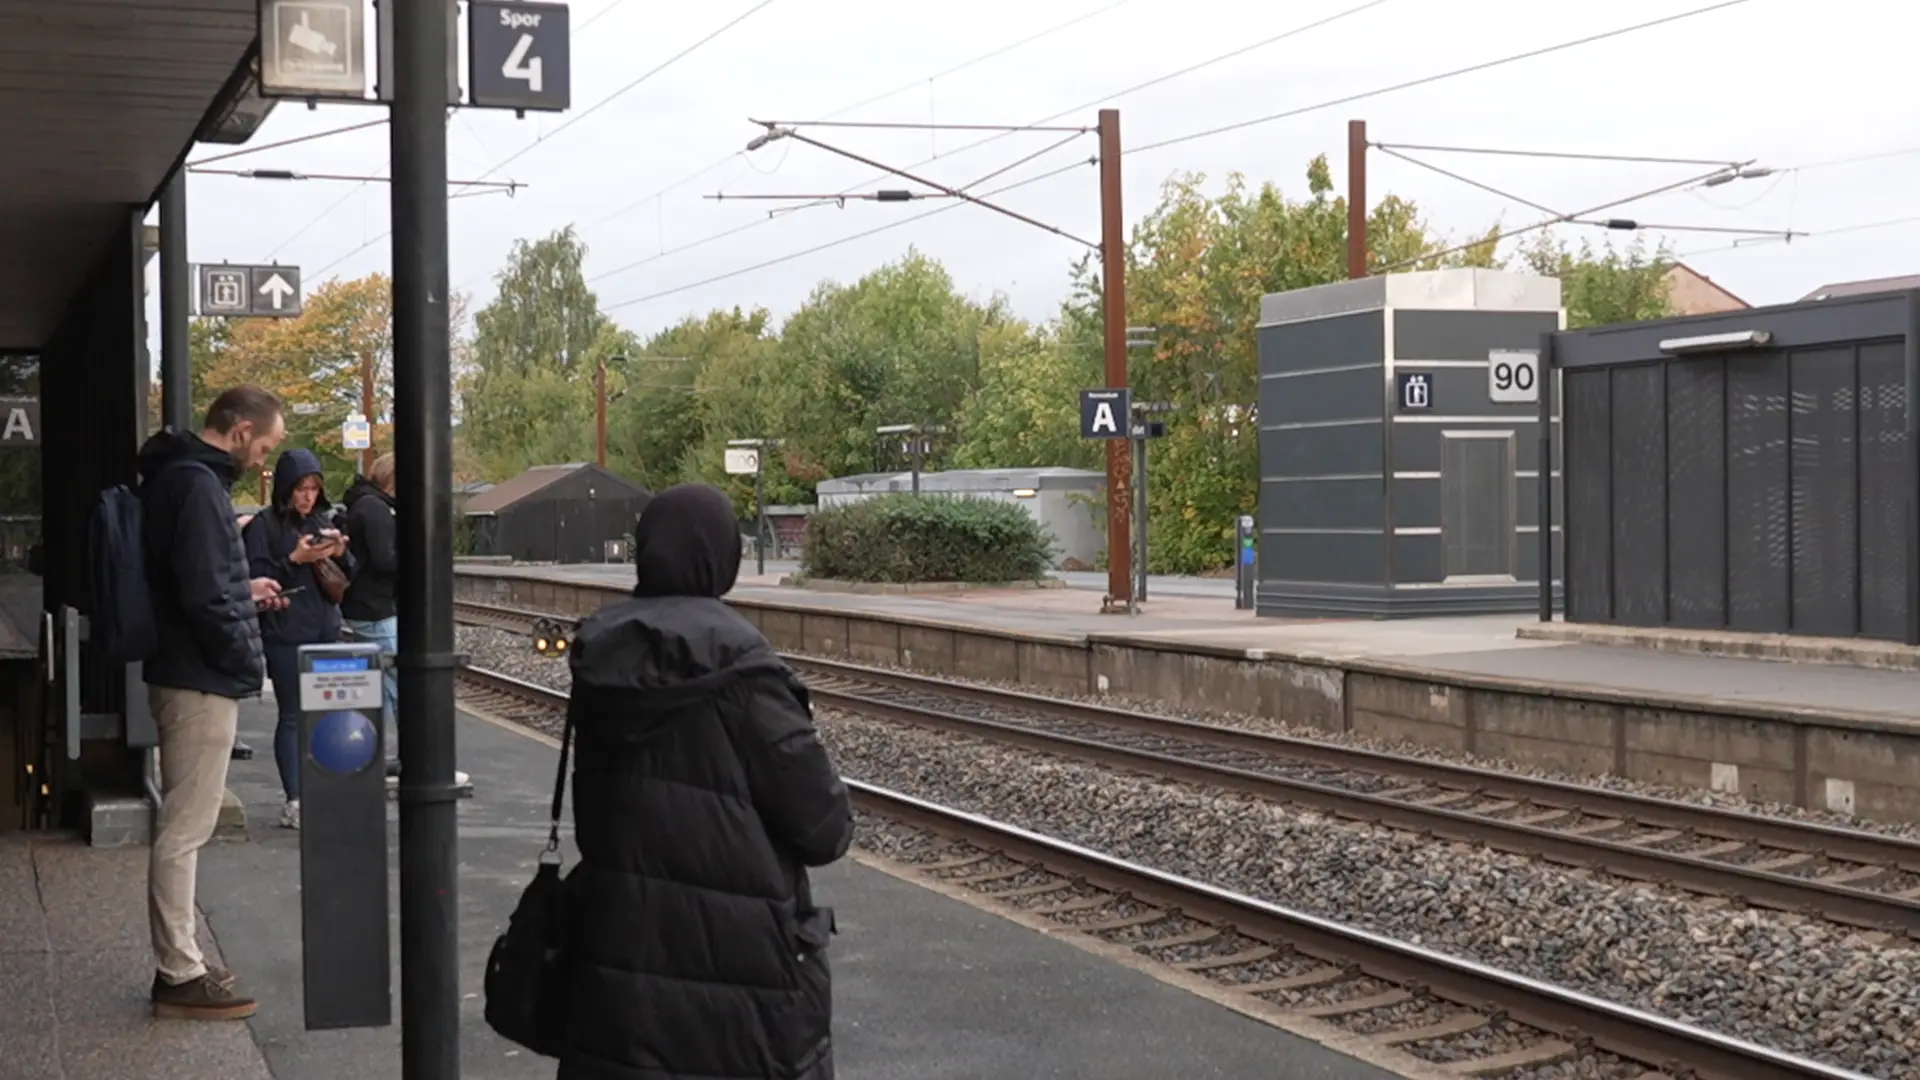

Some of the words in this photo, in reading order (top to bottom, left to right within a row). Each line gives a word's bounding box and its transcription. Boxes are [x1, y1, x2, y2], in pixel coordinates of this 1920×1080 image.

[500, 8, 541, 29] Spor
[502, 33, 542, 92] 4
[1495, 362, 1533, 390] 90
[3, 408, 34, 440] A
[1091, 402, 1117, 432] A
